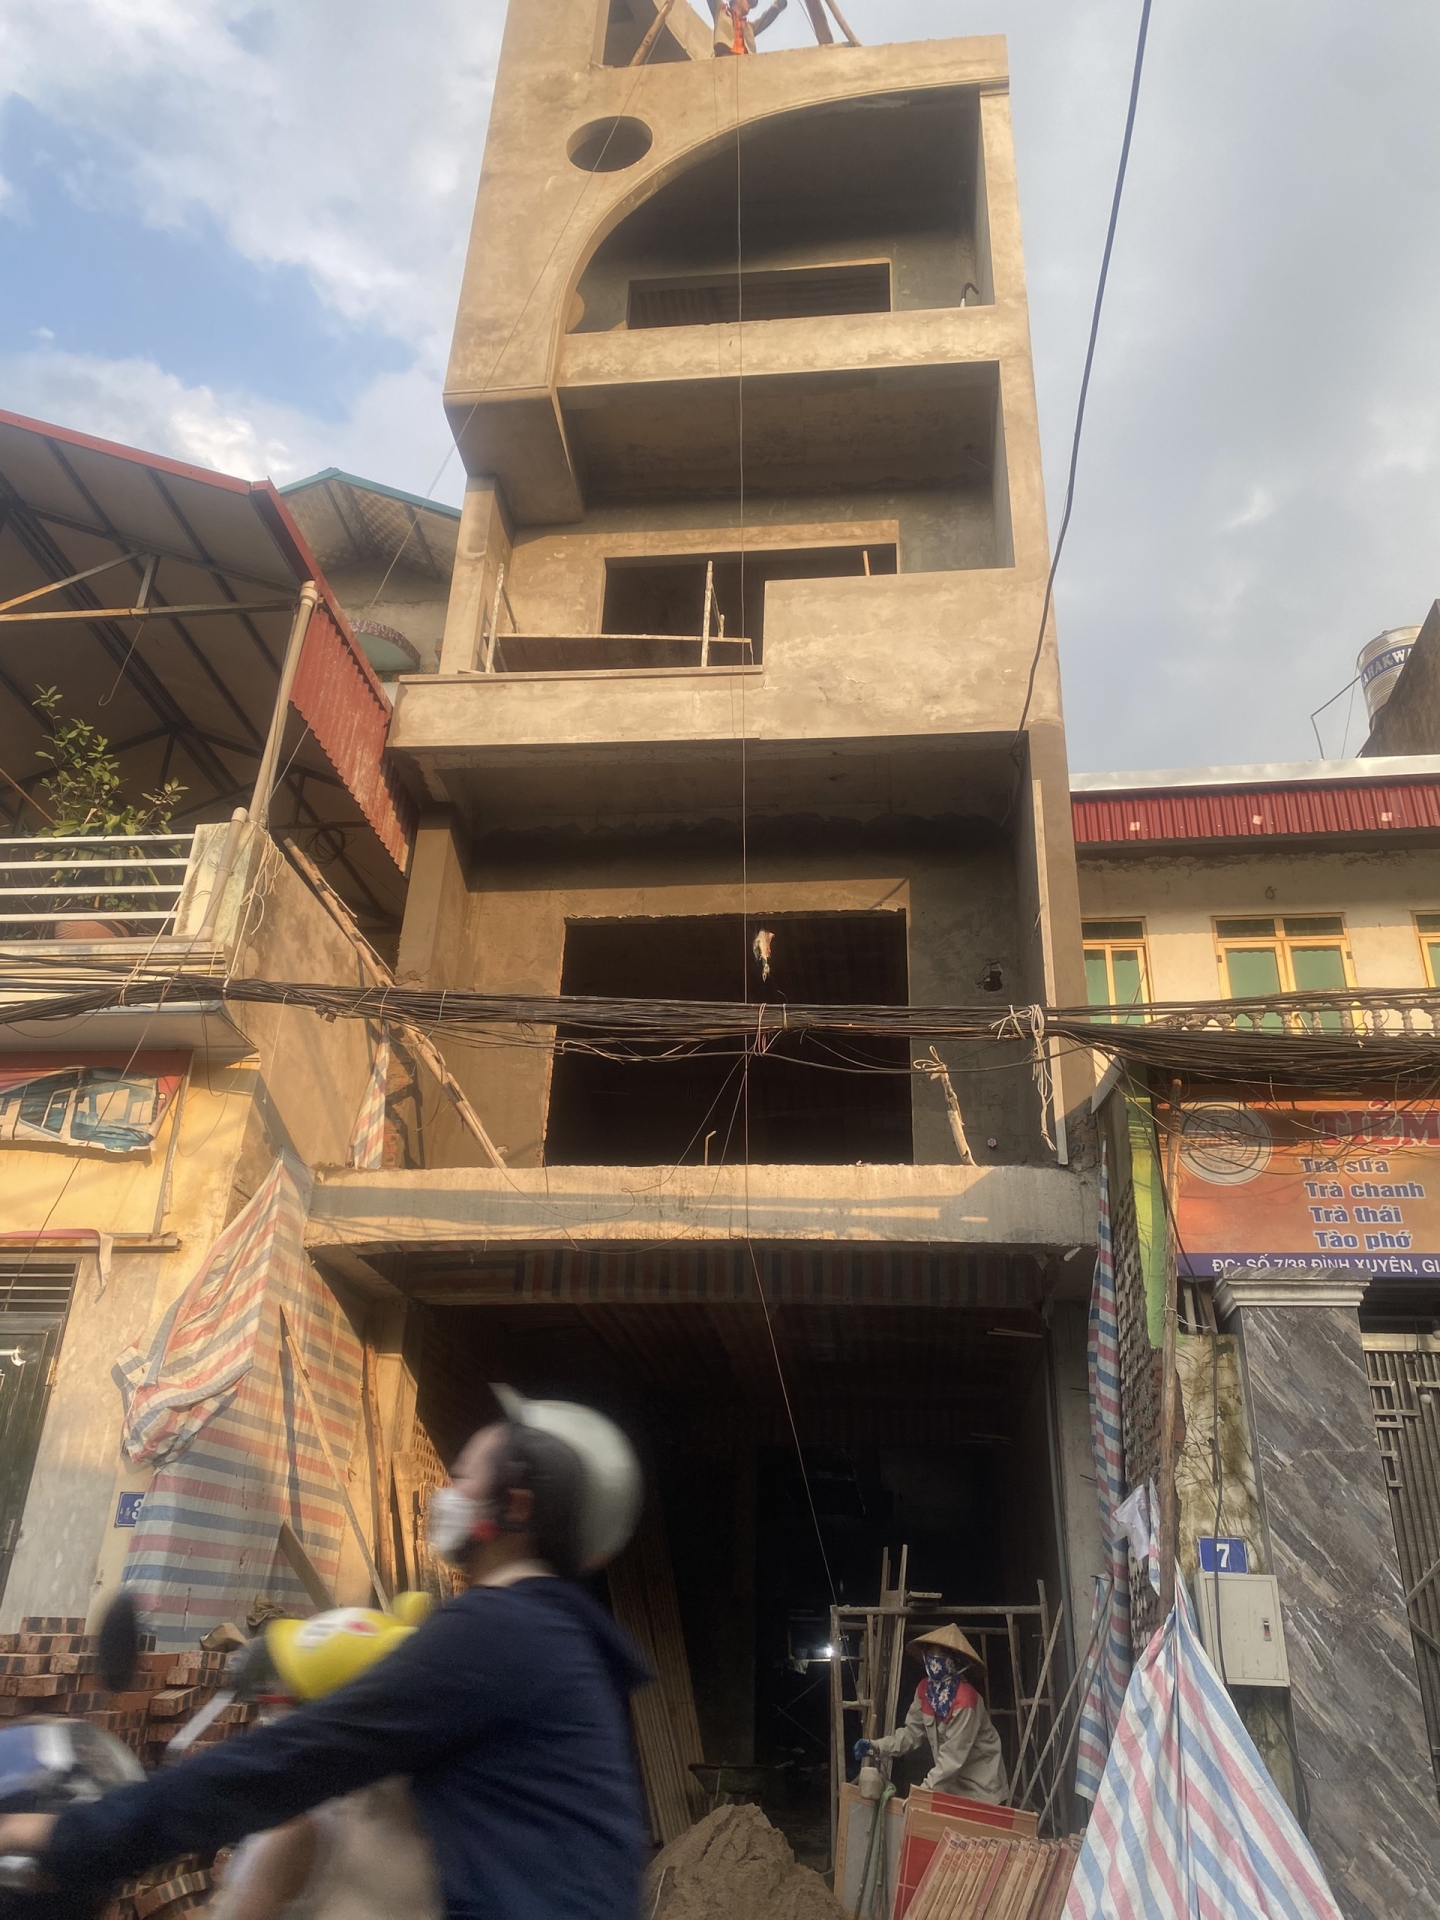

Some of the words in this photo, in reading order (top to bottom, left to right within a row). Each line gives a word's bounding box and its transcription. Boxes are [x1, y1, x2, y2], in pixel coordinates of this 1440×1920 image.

[1312, 1097, 1440, 1155] TIỆM
[1299, 1156, 1339, 1174] Trà
[1344, 1156, 1391, 1174] sữa
[1304, 1180, 1344, 1198] Trà
[1350, 1181, 1425, 1198] chanh
[1309, 1204, 1349, 1223] Trà
[1353, 1205, 1402, 1223] thái
[1314, 1230, 1358, 1249] Tào
[1364, 1230, 1412, 1250] phớ
[1246, 1254, 1270, 1268] SỐ
[1354, 1256, 1418, 1275] XUYÊN,
[1421, 1259, 1440, 1273] GI
[1216, 1543, 1230, 1568] 7
